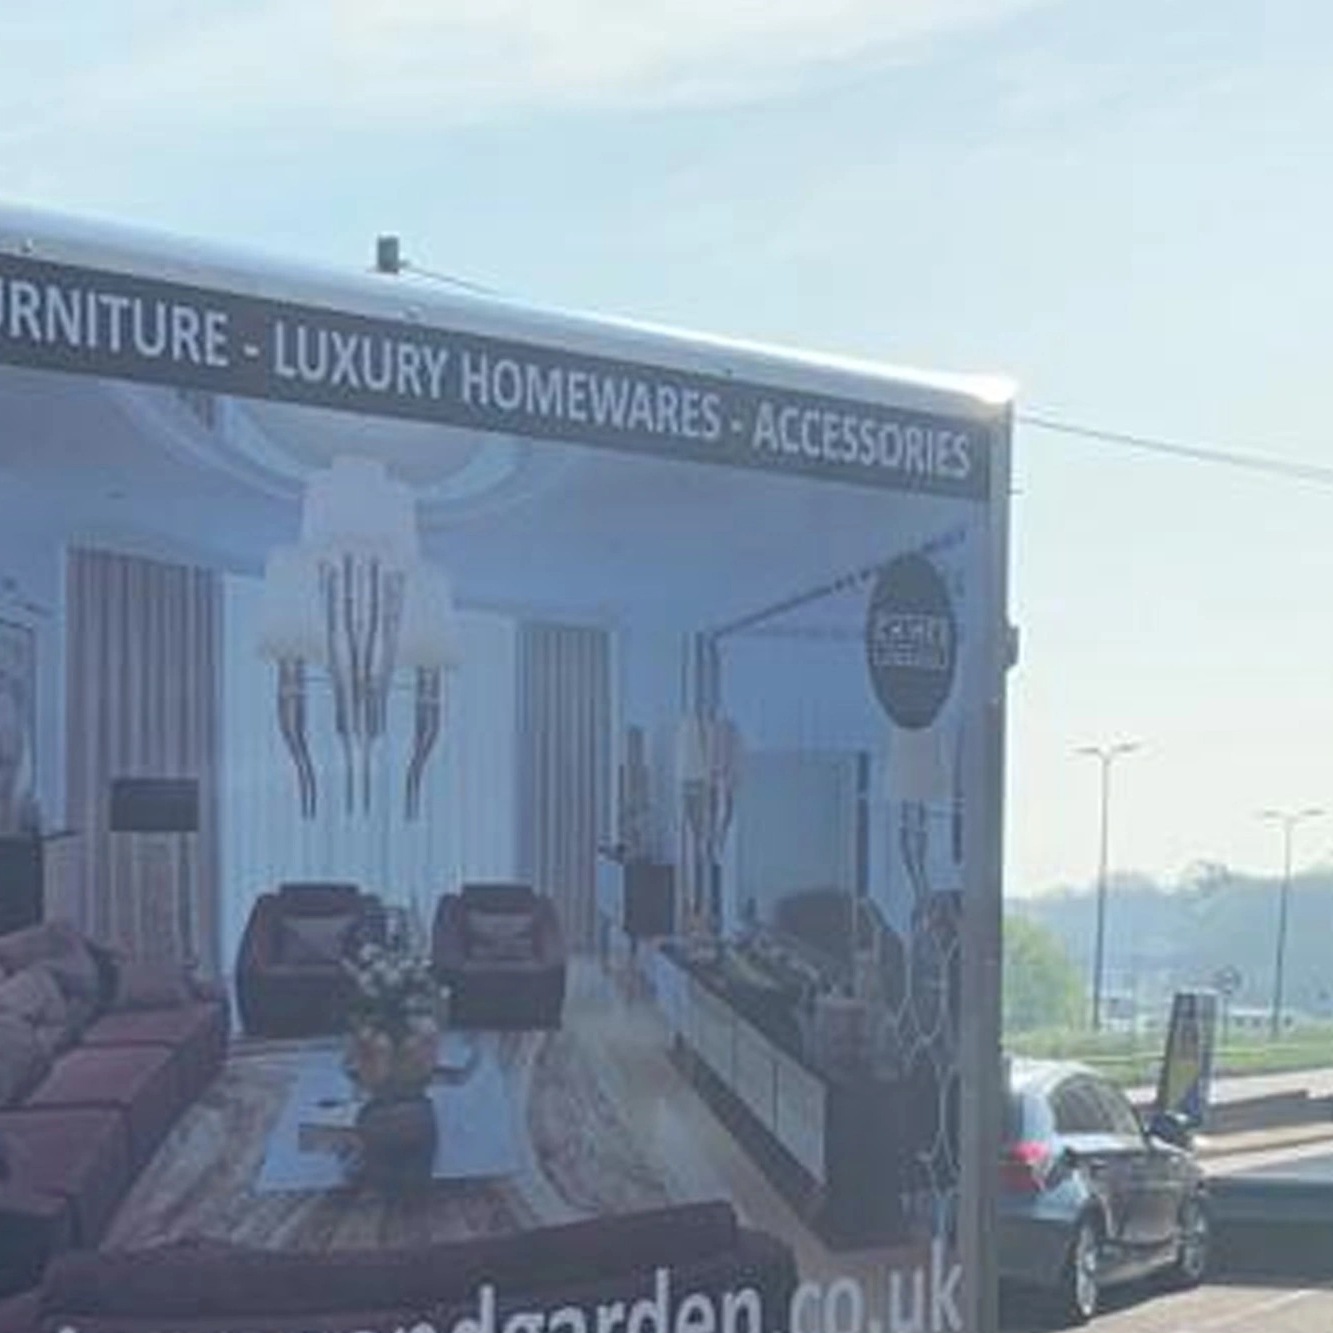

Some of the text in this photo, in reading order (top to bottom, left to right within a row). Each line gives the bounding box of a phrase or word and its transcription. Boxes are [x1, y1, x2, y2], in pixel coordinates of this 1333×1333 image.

[274, 320, 447, 399] LUXURY
[461, 353, 721, 442] HOMEWARES
[754, 404, 972, 478] ACCESSORIES
